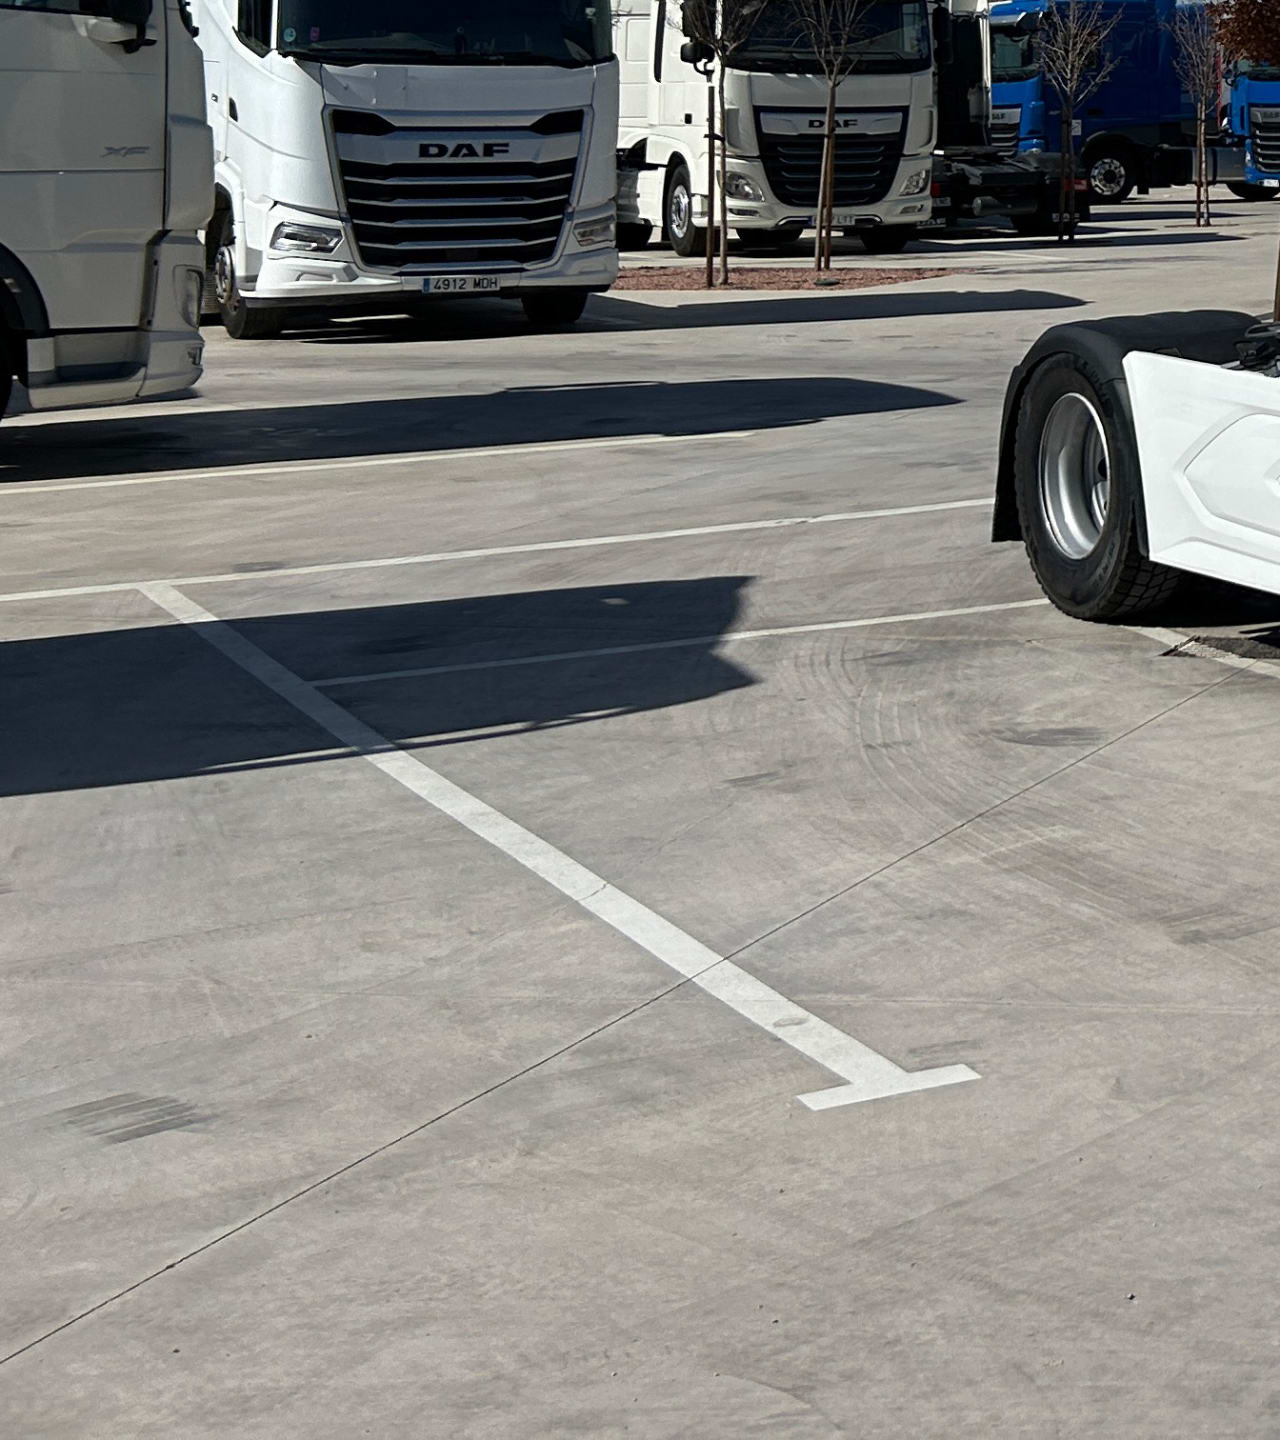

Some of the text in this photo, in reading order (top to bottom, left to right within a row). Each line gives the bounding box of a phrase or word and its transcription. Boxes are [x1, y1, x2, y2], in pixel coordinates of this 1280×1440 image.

[102, 146, 150, 157] XF
[419, 143, 510, 158] DAF
[433, 276, 498, 290] 4912 MDH
